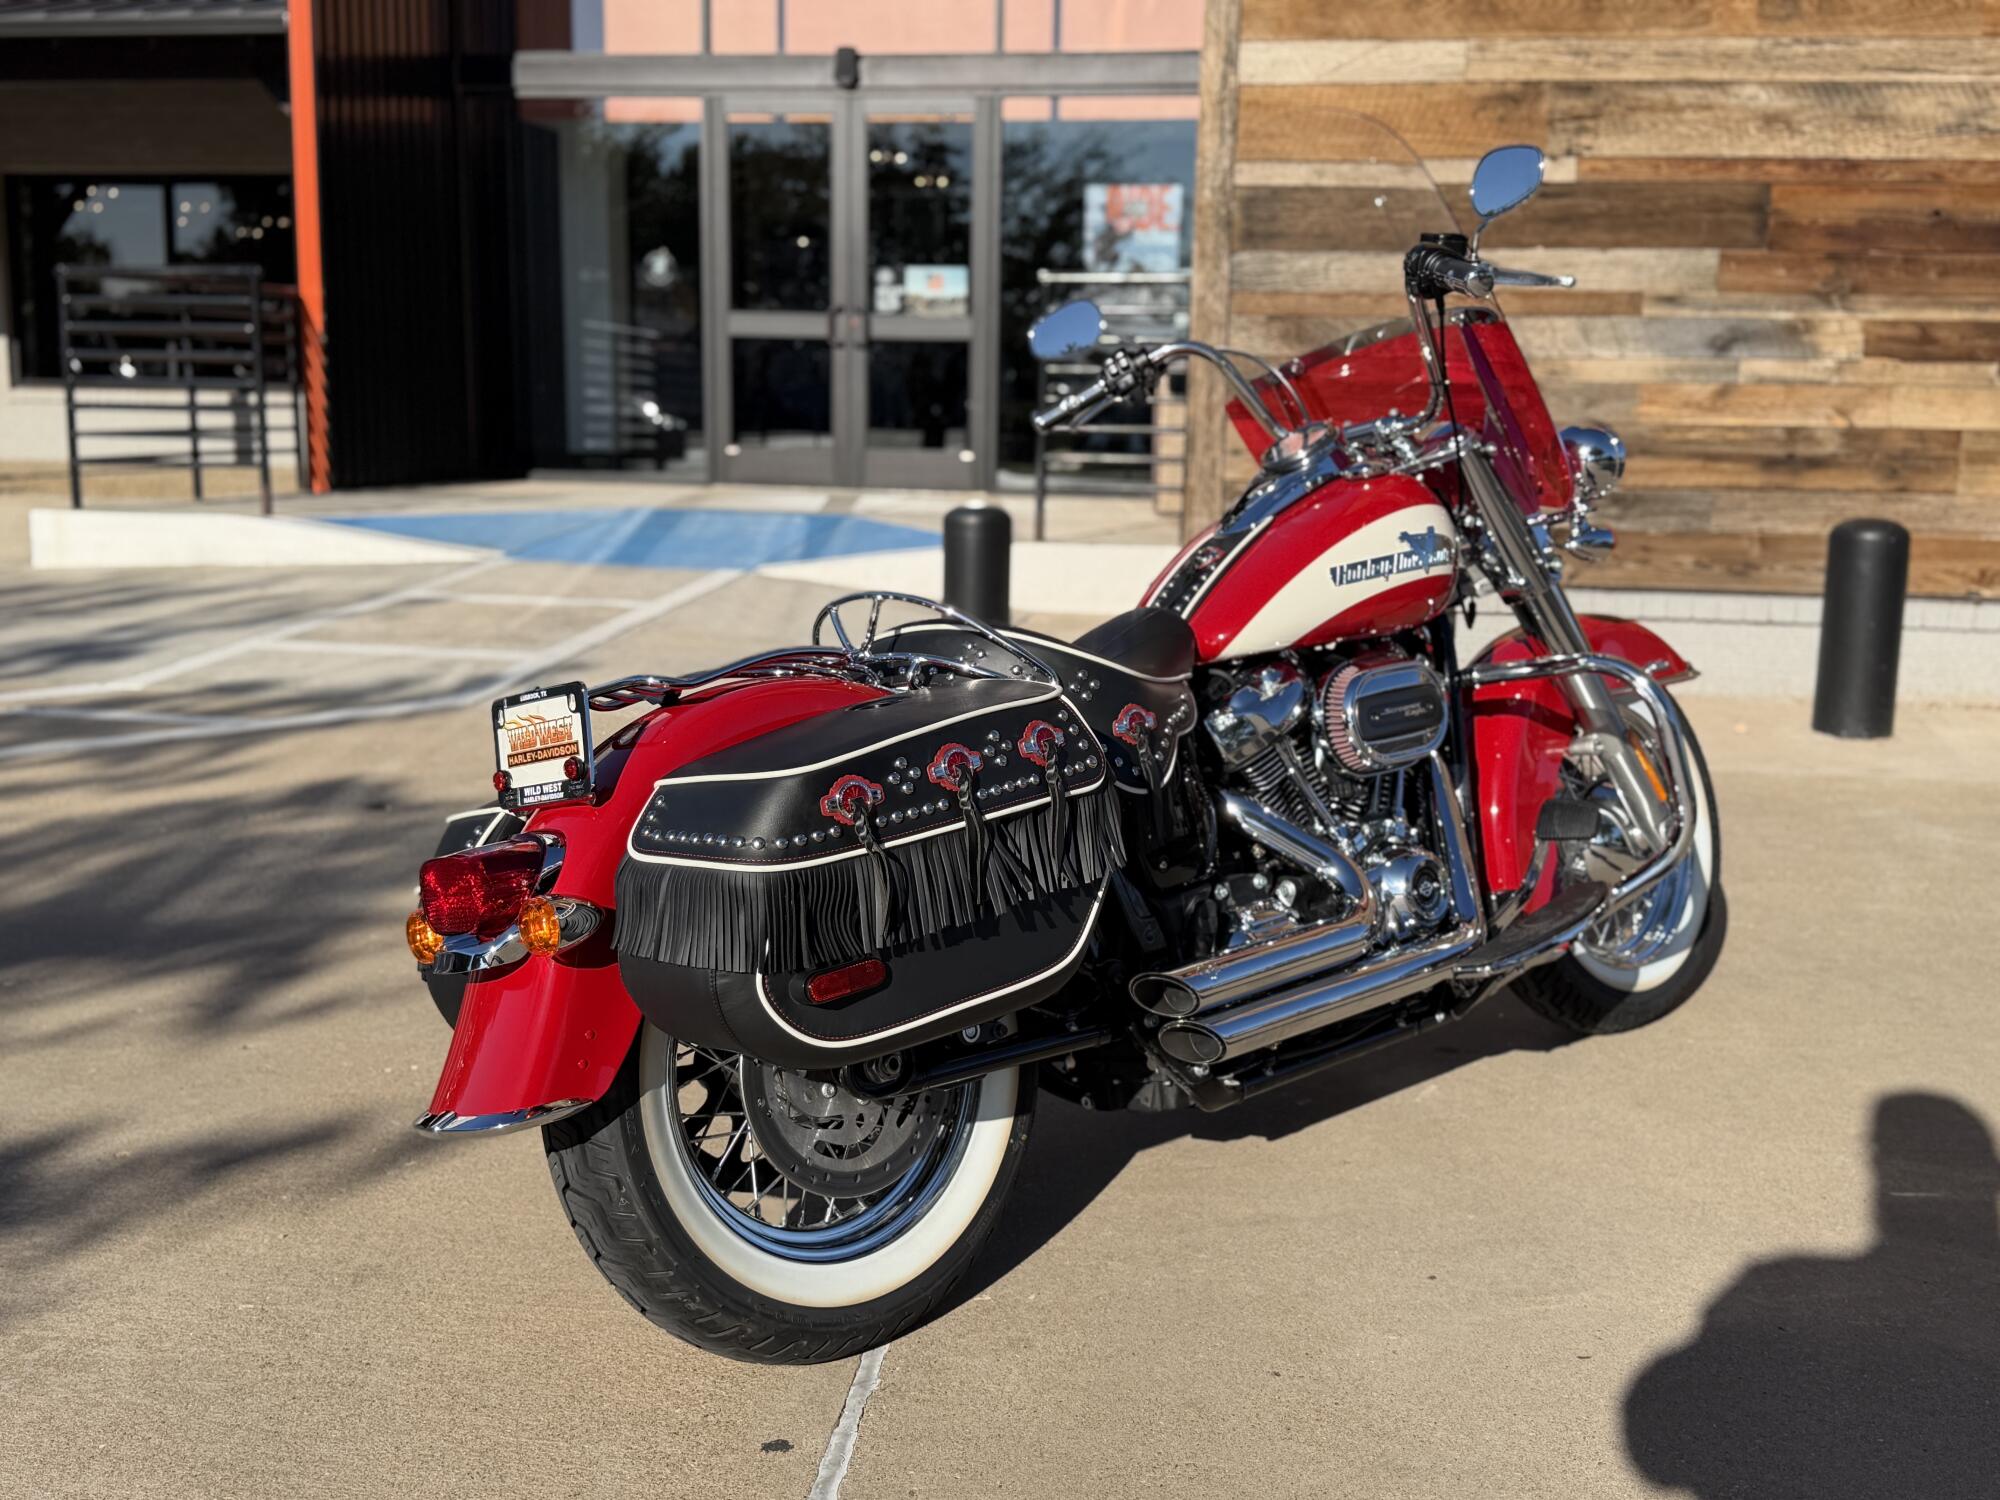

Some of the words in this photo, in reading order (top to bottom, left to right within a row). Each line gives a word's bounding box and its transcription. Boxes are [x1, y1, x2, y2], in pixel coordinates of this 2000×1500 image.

[507, 724, 537, 752] WILD
[537, 715, 574, 746] WEST
[508, 745, 578, 766] HARLEY-DAVIDSON
[523, 785, 542, 797] WILD
[542, 782, 563, 794] WEST
